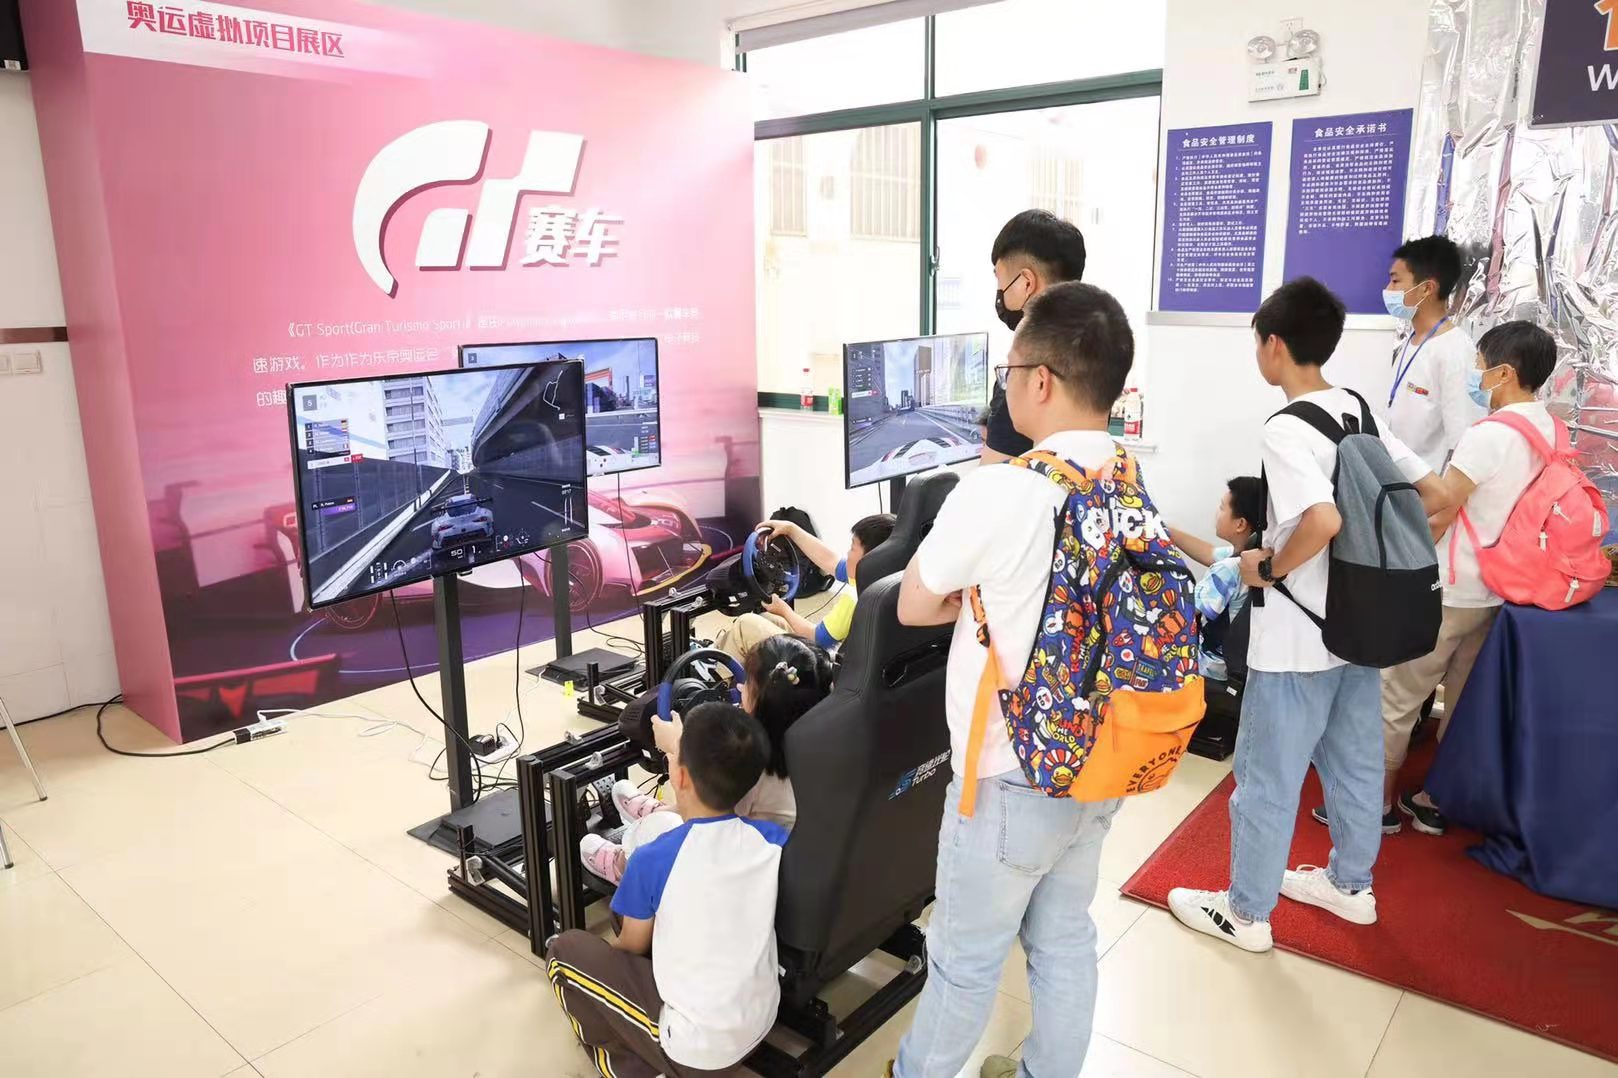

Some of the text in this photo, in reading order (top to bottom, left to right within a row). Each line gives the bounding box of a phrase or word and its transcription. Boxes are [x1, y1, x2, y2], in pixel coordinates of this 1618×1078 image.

[127, 1, 345, 58] 奥运虚拟项目展区
[1182, 134, 1255, 149] 食品安全管理制度
[1314, 122, 1388, 138] 食品安全承诺书
[519, 204, 624, 267] 赛车
